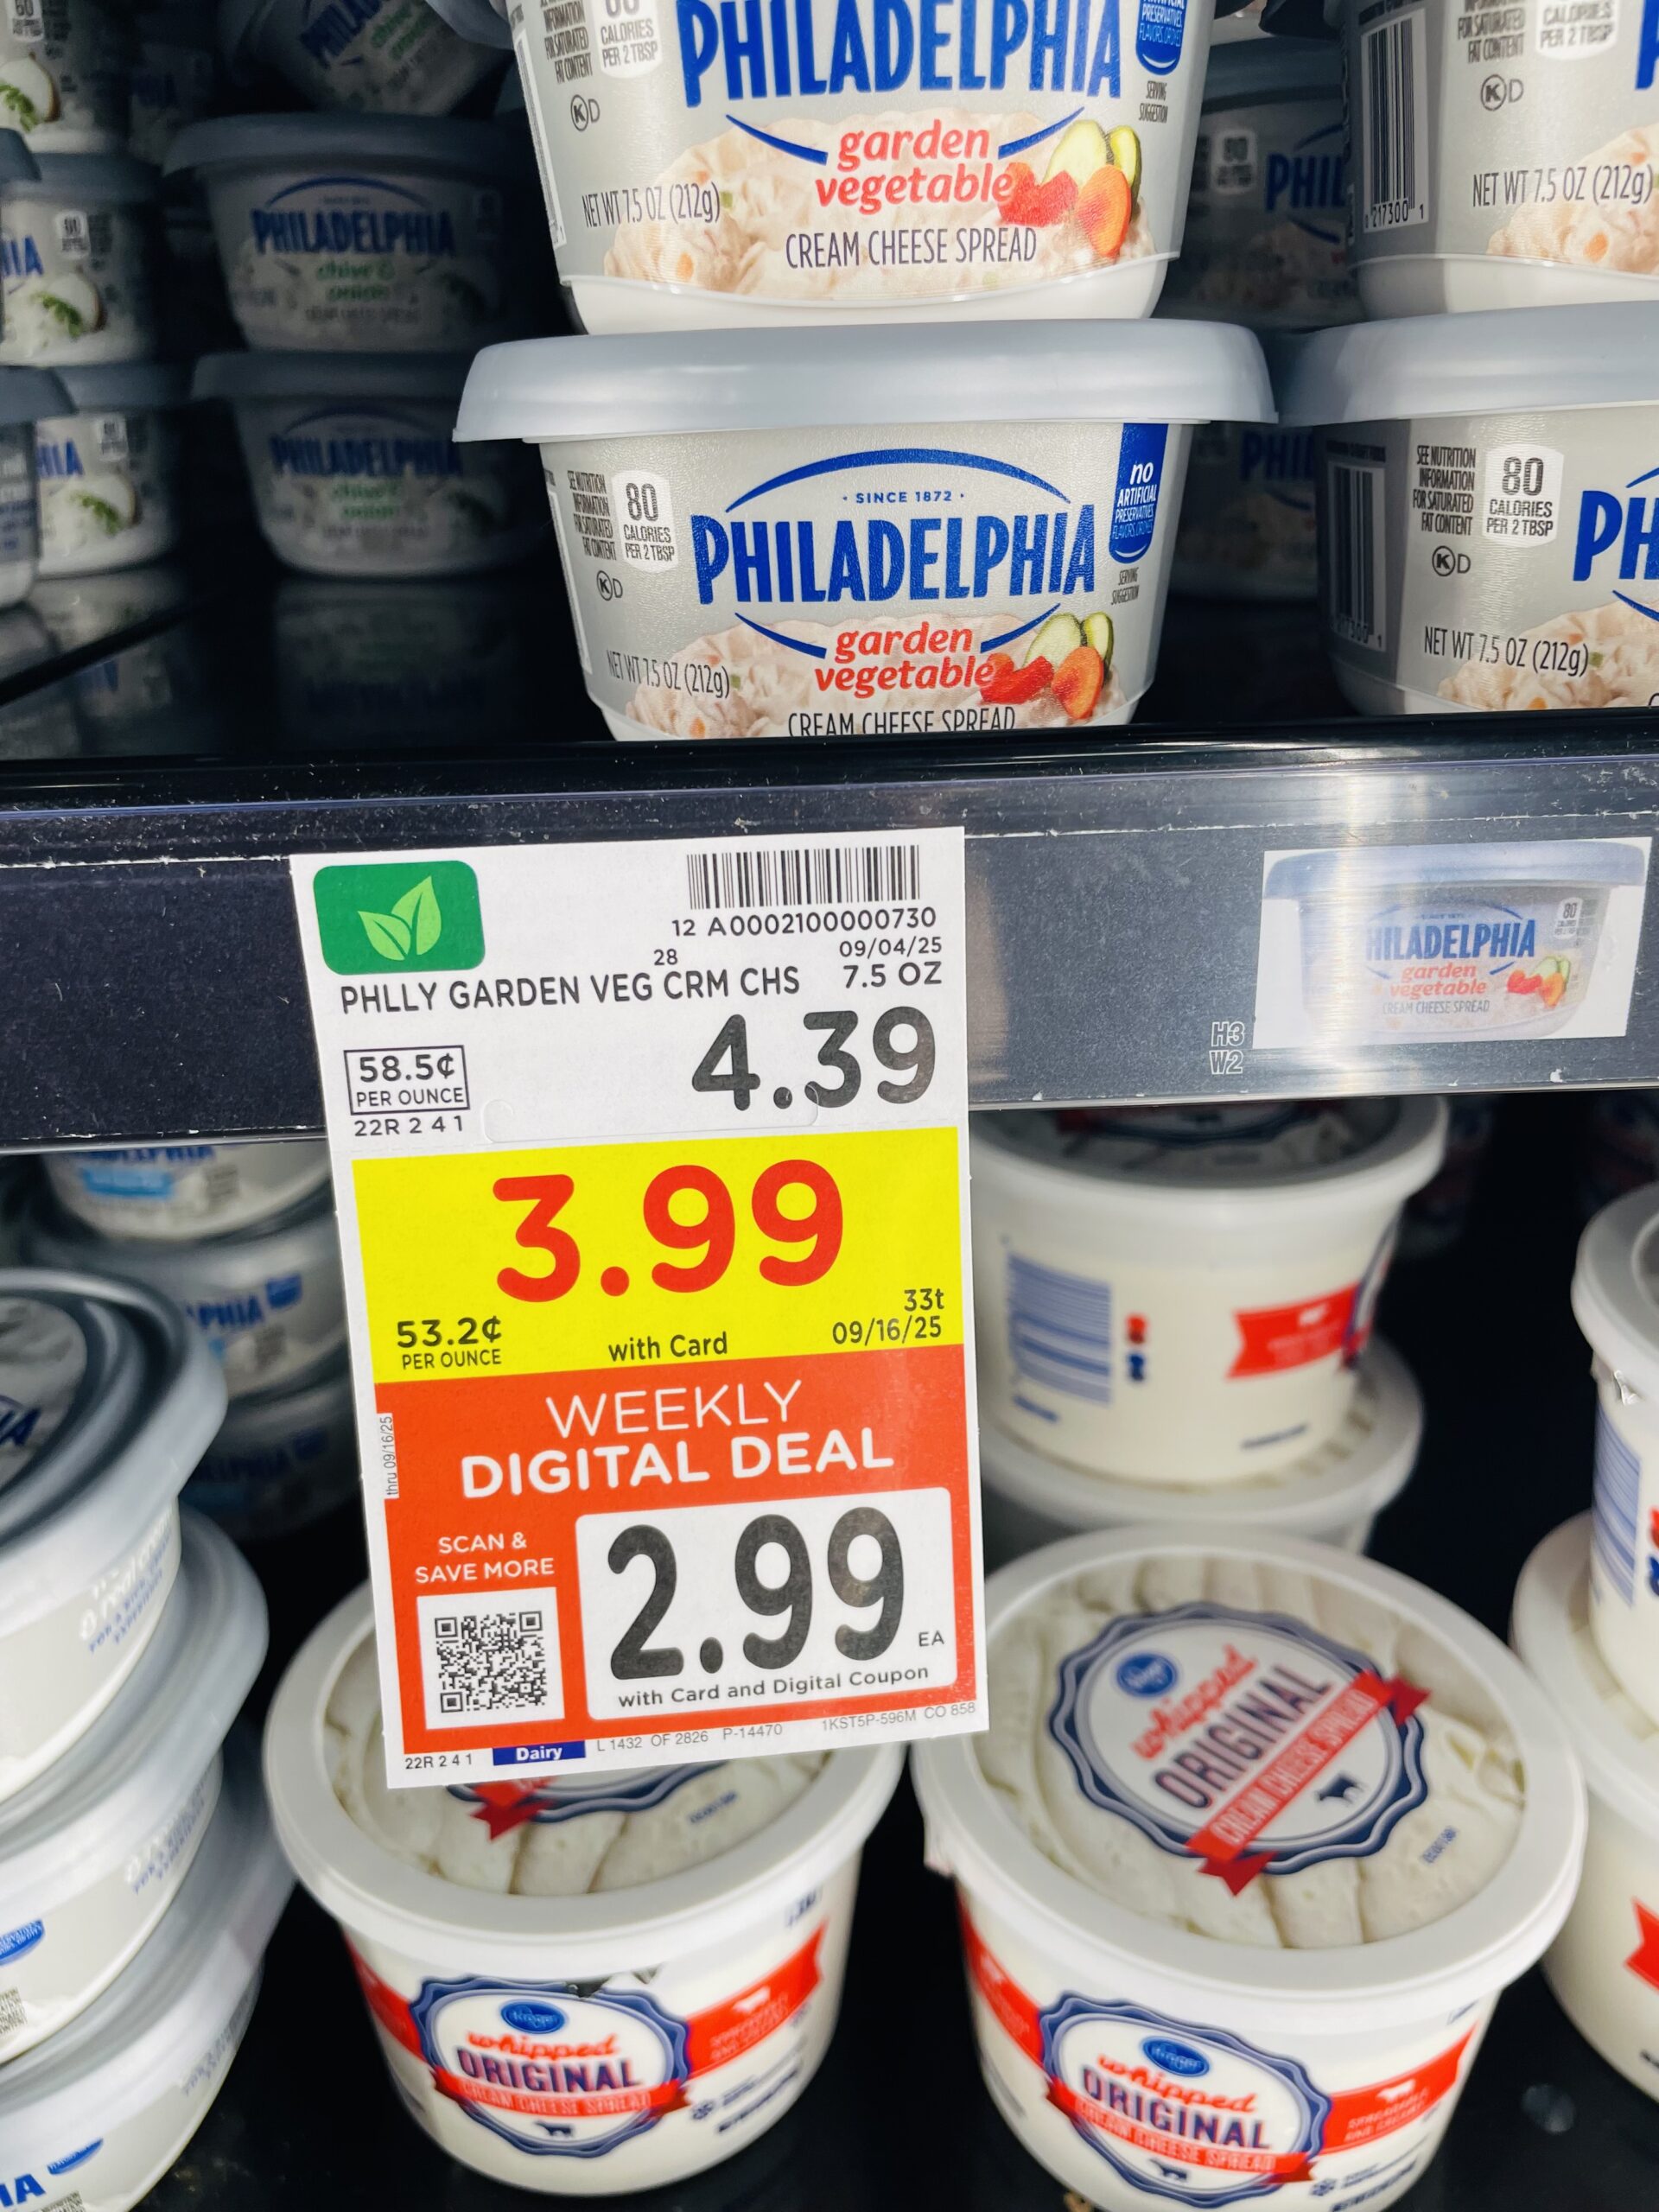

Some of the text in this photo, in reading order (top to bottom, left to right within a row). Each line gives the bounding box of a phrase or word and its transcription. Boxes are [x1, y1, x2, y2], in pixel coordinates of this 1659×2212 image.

[1474, 8, 1525, 36] SATURATED
[1543, 3, 1613, 26] CALORIES
[601, 19, 654, 45] CALORIES
[1541, 29, 1566, 49] PER
[1568, 27, 1577, 45] 2
[602, 41, 658, 67] PER 2 TBSP
[678, 0, 1121, 108] PHILADELPHIA
[1483, 34, 1523, 61] CONTENT
[1146, 80, 1167, 101] SERVING
[1139, 103, 1168, 124] SUGGESTION
[839, 118, 989, 169] garden
[816, 163, 1014, 215] vegetable
[1472, 163, 1656, 208] NET WT 7.5 OZ (212g)
[582, 181, 721, 228] NET WT 7.5 OZ (212g)
[785, 226, 1038, 270] CREAM CHEESE SPREAD
[1416, 445, 1477, 468] SEE NUTRITION
[1129, 461, 1154, 486] no
[1419, 467, 1475, 491] INFORMATION
[1502, 456, 1545, 496] 80
[626, 482, 659, 522] 80
[855, 489, 953, 504] SINCE 1872
[1116, 484, 1157, 507] ARTIFICIAL
[1413, 489, 1474, 513] FOR SATURATED
[1489, 499, 1553, 518] CALORIES
[623, 524, 672, 543] CALORIES
[1421, 512, 1473, 536] FAT CONTENT
[1485, 518, 1554, 537] PER 2 TBSP
[625, 543, 676, 562] PER 2 TBSP
[690, 504, 1096, 605] PHILADELPHIA
[1118, 566, 1139, 586] SERVING
[1111, 585, 1140, 606] SUGGESTION
[834, 621, 974, 664] garden
[1425, 626, 1589, 677] NET WT 7.5 OZ (212g)
[606, 650, 730, 700] NET WT 7.5 OZ (212g)
[814, 656, 998, 699] vegetable
[787, 706, 1015, 737] CREAM CHEESE SPREAD
[671, 907, 937, 938] 12 A0002100000730
[1562, 902, 1579, 919] 80
[838, 937, 943, 959] 09/04/25
[1366, 919, 1535, 962] HILADELPHIA
[653, 949, 678, 967] 28
[842, 962, 944, 990] 7.5 OZ
[1401, 962, 1478, 984] garden
[340, 965, 801, 1015] PHLLY GARDEN VEG CRM CHS
[1389, 979, 1488, 1001] vegetable
[1382, 999, 1491, 1015] CREAM CHEESE SPREAD
[358, 1052, 456, 1085] 58.5¢
[690, 1005, 938, 1113] 4.39
[1210, 1050, 1244, 1075] W2
[355, 1086, 465, 1108] PER OUNCE
[353, 1115, 464, 1137] 22R 2 4 1
[492, 1158, 845, 1303] 3.99
[903, 1287, 945, 1313] 33t
[396, 1314, 504, 1349] 53.2¢
[831, 1315, 944, 1345] 09/16/25
[401, 1348, 502, 1370] PER OUNCE
[608, 1331, 729, 1363] with Card
[544, 1379, 804, 1440] WEEKLY
[379, 1416, 399, 1496] thru 09/16/25
[461, 1427, 895, 1499] DIGITAL DEAL
[437, 1529, 528, 1554] SCAN &
[415, 1556, 556, 1585] SAVE MORE
[607, 1505, 906, 1681] 2.99
[918, 1630, 945, 1648] EA
[617, 1665, 931, 1709] with Card and Digital Coupon
[821, 1701, 977, 1734] 1KST5P-596M CO 858
[610, 1730, 709, 1751] 1432 OF 2826
[722, 1724, 783, 1743] P-14470
[1152, 1664, 1334, 1808] ORIGINAL
[404, 1754, 461, 1770] 22R 2 4
[514, 1743, 563, 1764] Dairy
[467, 2031, 619, 2060] whipped
[456, 2046, 643, 2094] ORIGINAL
[1097, 2055, 1258, 2113] whipped
[1083, 2064, 1271, 2150] ORIGINAL
